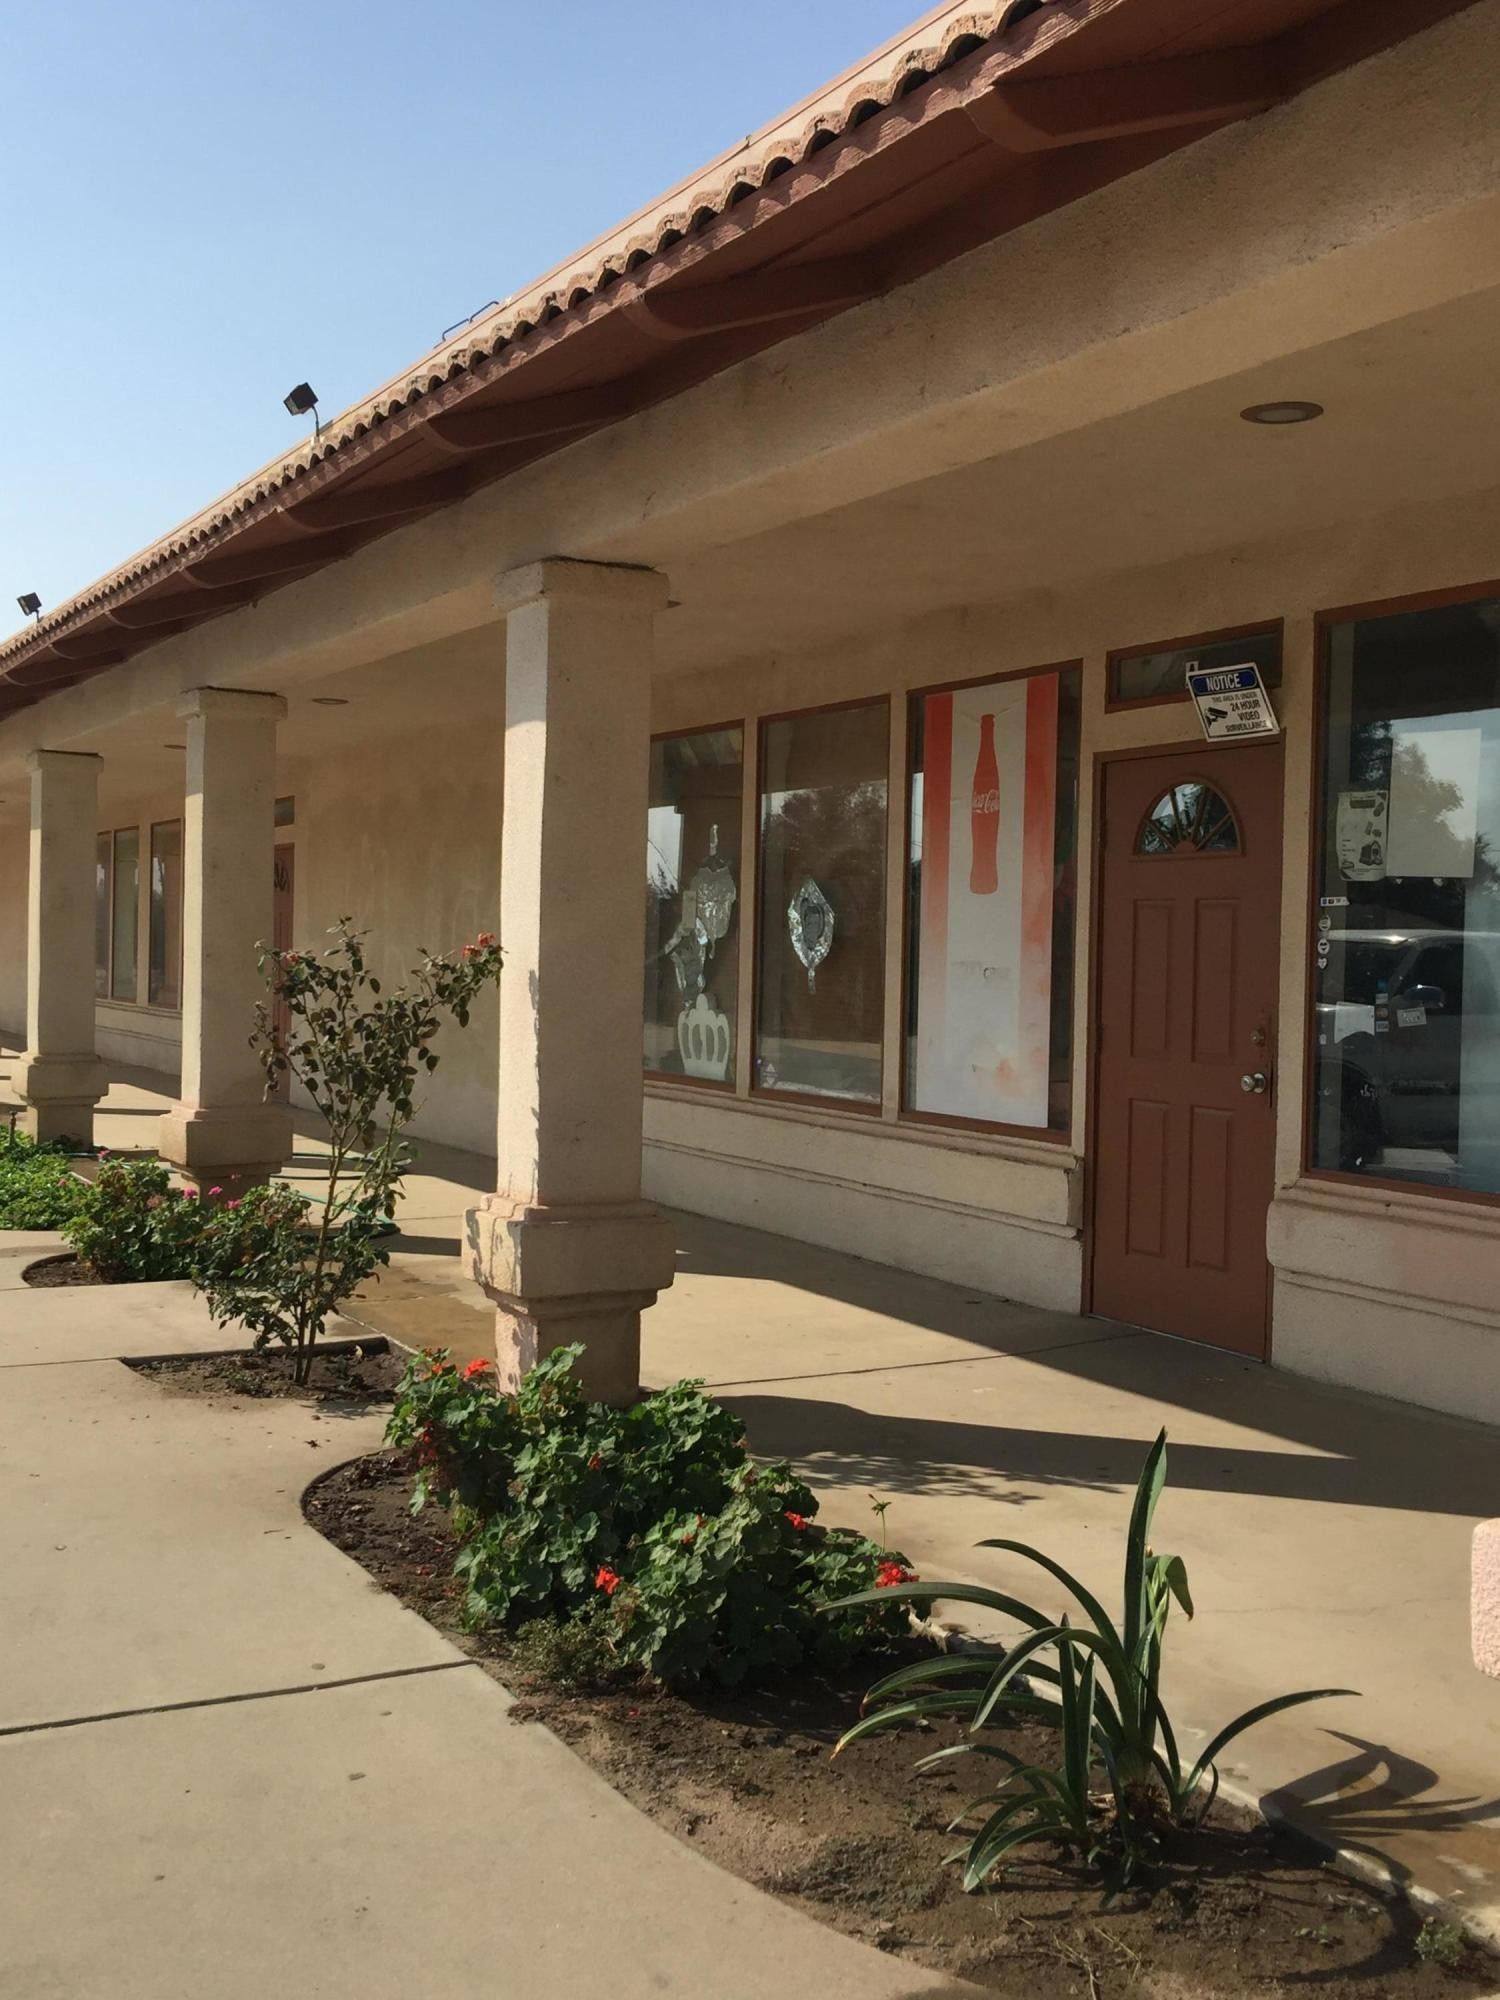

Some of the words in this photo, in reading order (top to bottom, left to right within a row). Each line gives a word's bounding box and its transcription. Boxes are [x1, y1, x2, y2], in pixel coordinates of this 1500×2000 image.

[1206, 673, 1241, 691] NOTICE
[1230, 702, 1240, 711] 24
[1240, 699, 1260, 710] HOUR
[1238, 710, 1260, 720] VIDEO
